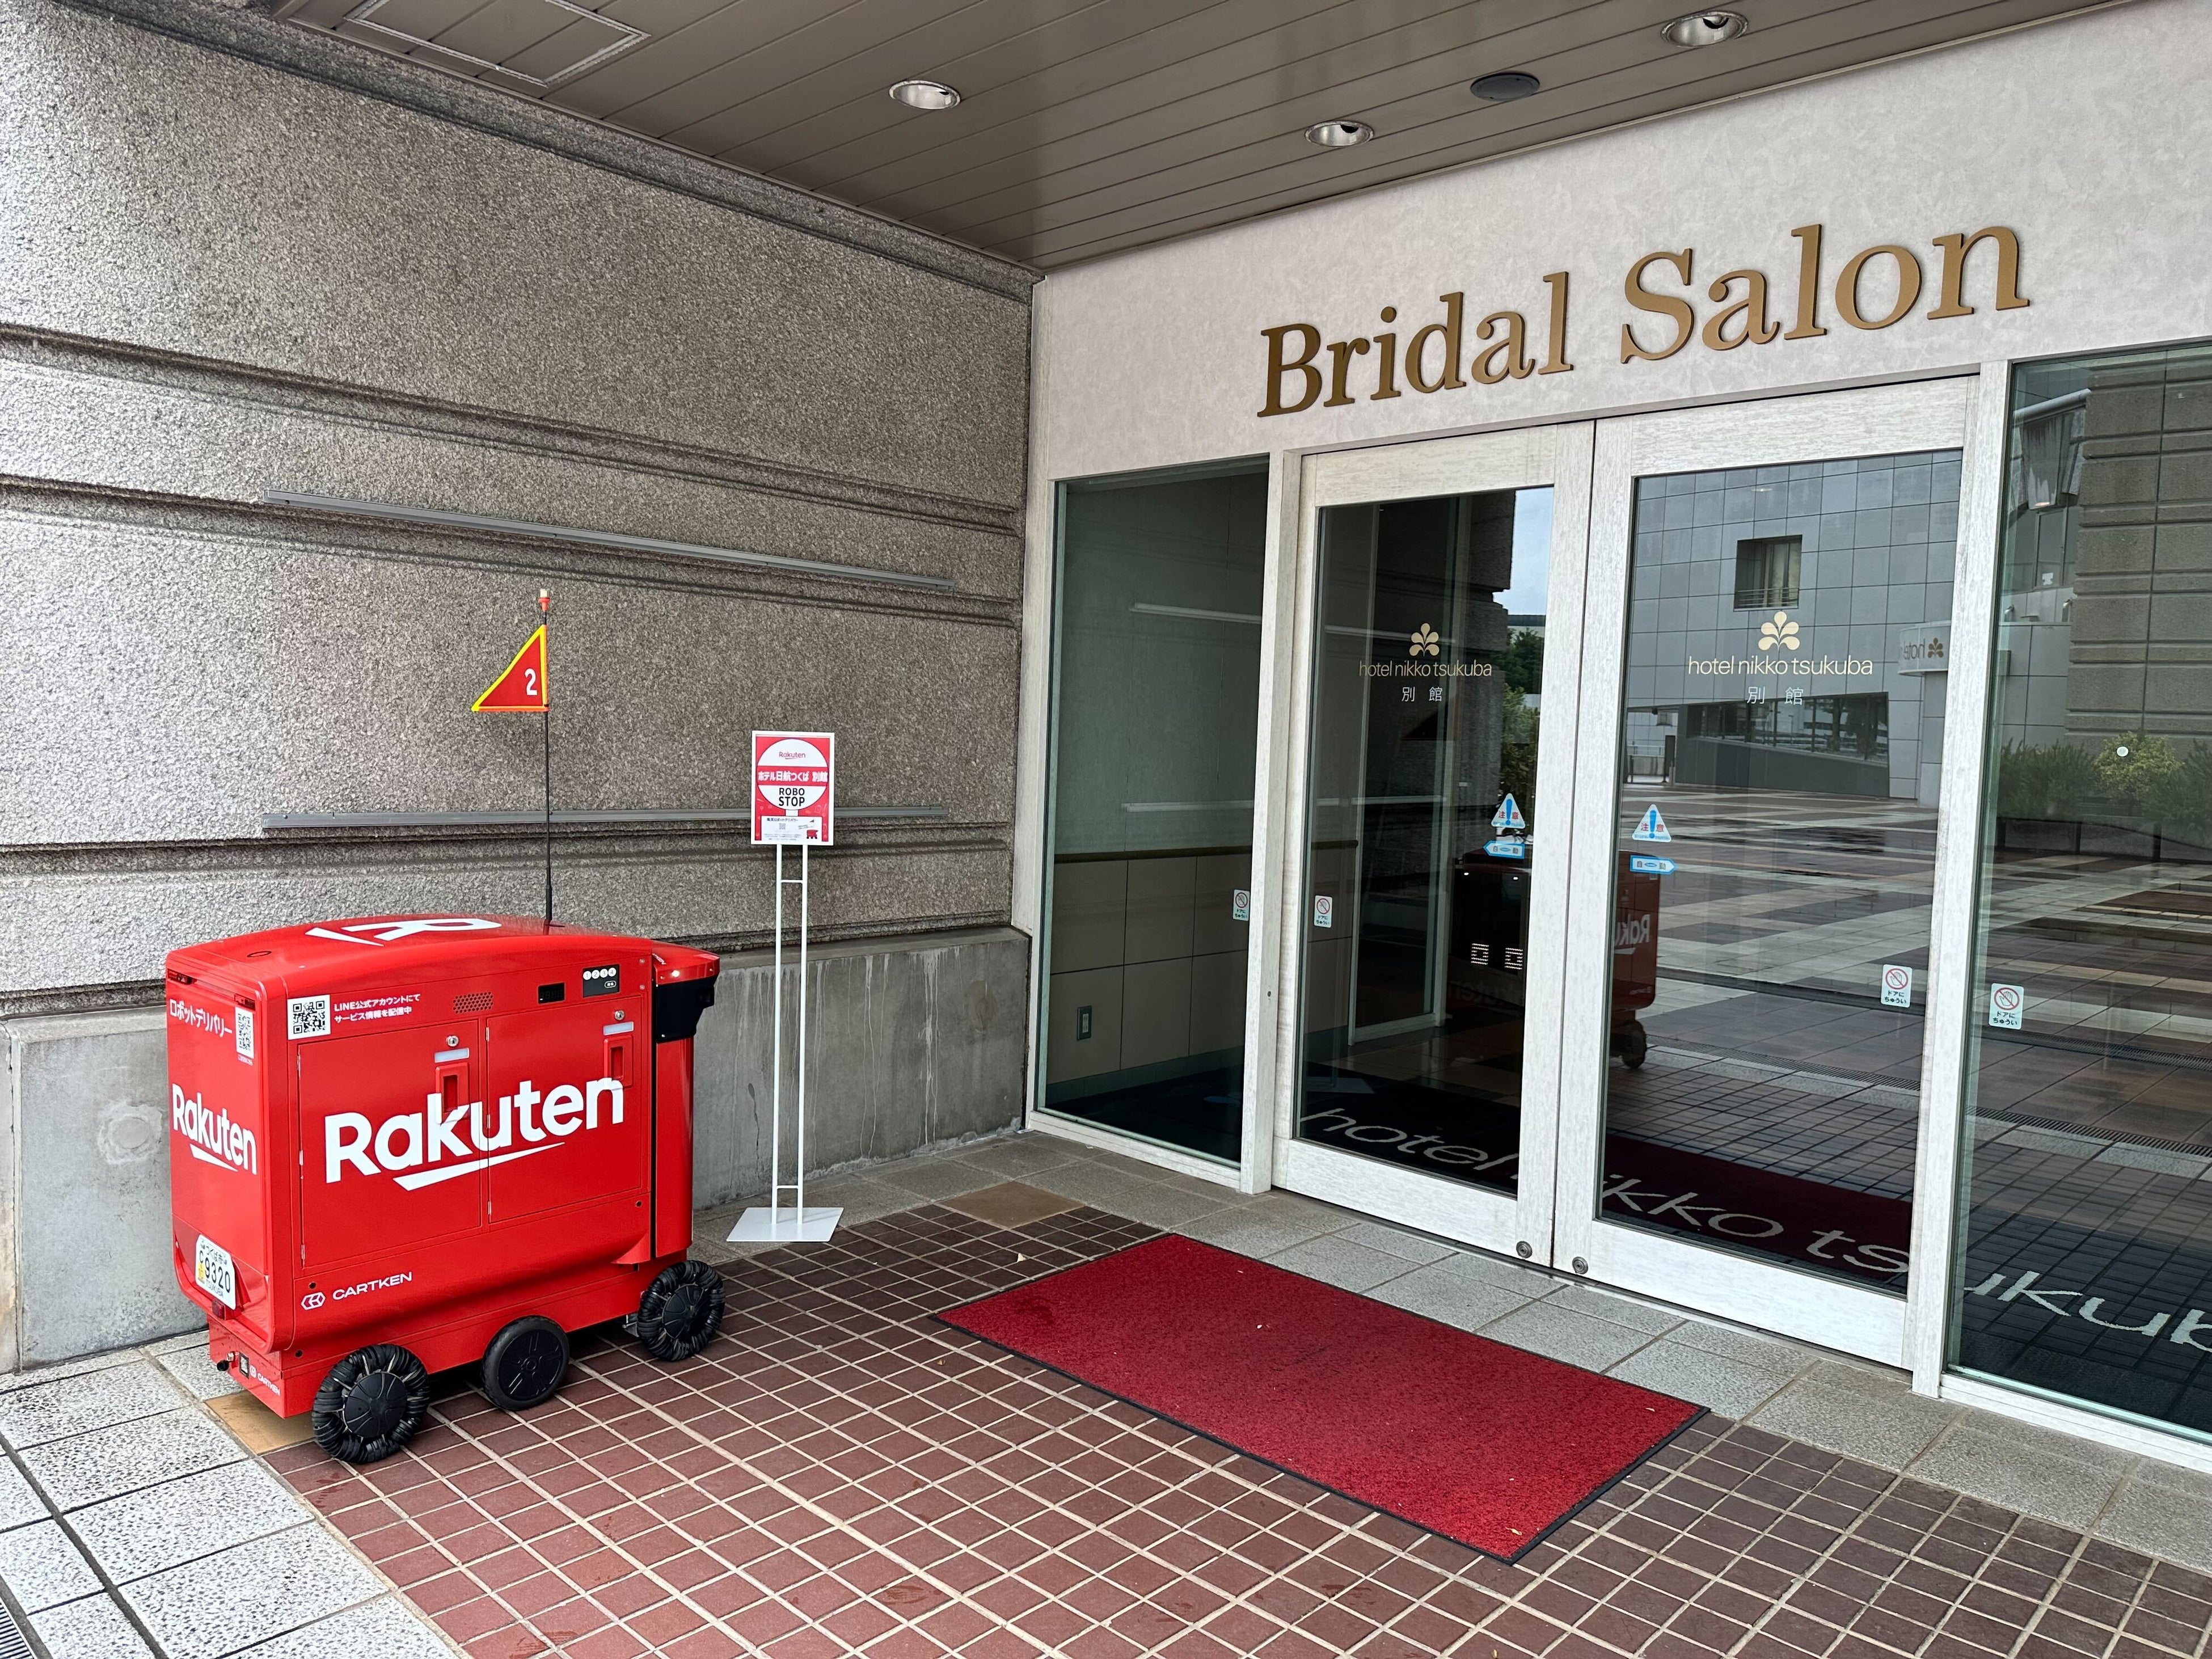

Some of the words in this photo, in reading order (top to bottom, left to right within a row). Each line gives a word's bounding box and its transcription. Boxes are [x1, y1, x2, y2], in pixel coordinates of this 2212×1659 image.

[1257, 271, 1574, 418] Bridal
[1620, 223, 2031, 365] Salon
[1359, 660, 1392, 677] hotel
[1395, 660, 1431, 677] nikko
[1433, 659, 1492, 677] tsukuba
[1688, 656, 1734, 675] hotel
[1738, 655, 1788, 675] nikko
[1791, 655, 1873, 676] tsukuba
[524, 668, 538, 696] 2
[758, 771, 809, 782] ホテル日航つくば
[779, 787, 805, 796] ROBO
[779, 796, 805, 807] STOP
[334, 994, 421, 1012] LINE公式アカウントにて
[170, 999, 233, 1038] ロボットデリバリー
[334, 1006, 412, 1023] サービス情報を配信中
[172, 1083, 257, 1175] Rakuten
[325, 1077, 624, 1184] Rakuten
[206, 1246, 224, 1264] つくば市
[205, 1257, 230, 1293] 9320
[332, 1271, 412, 1301] CARTKEN
